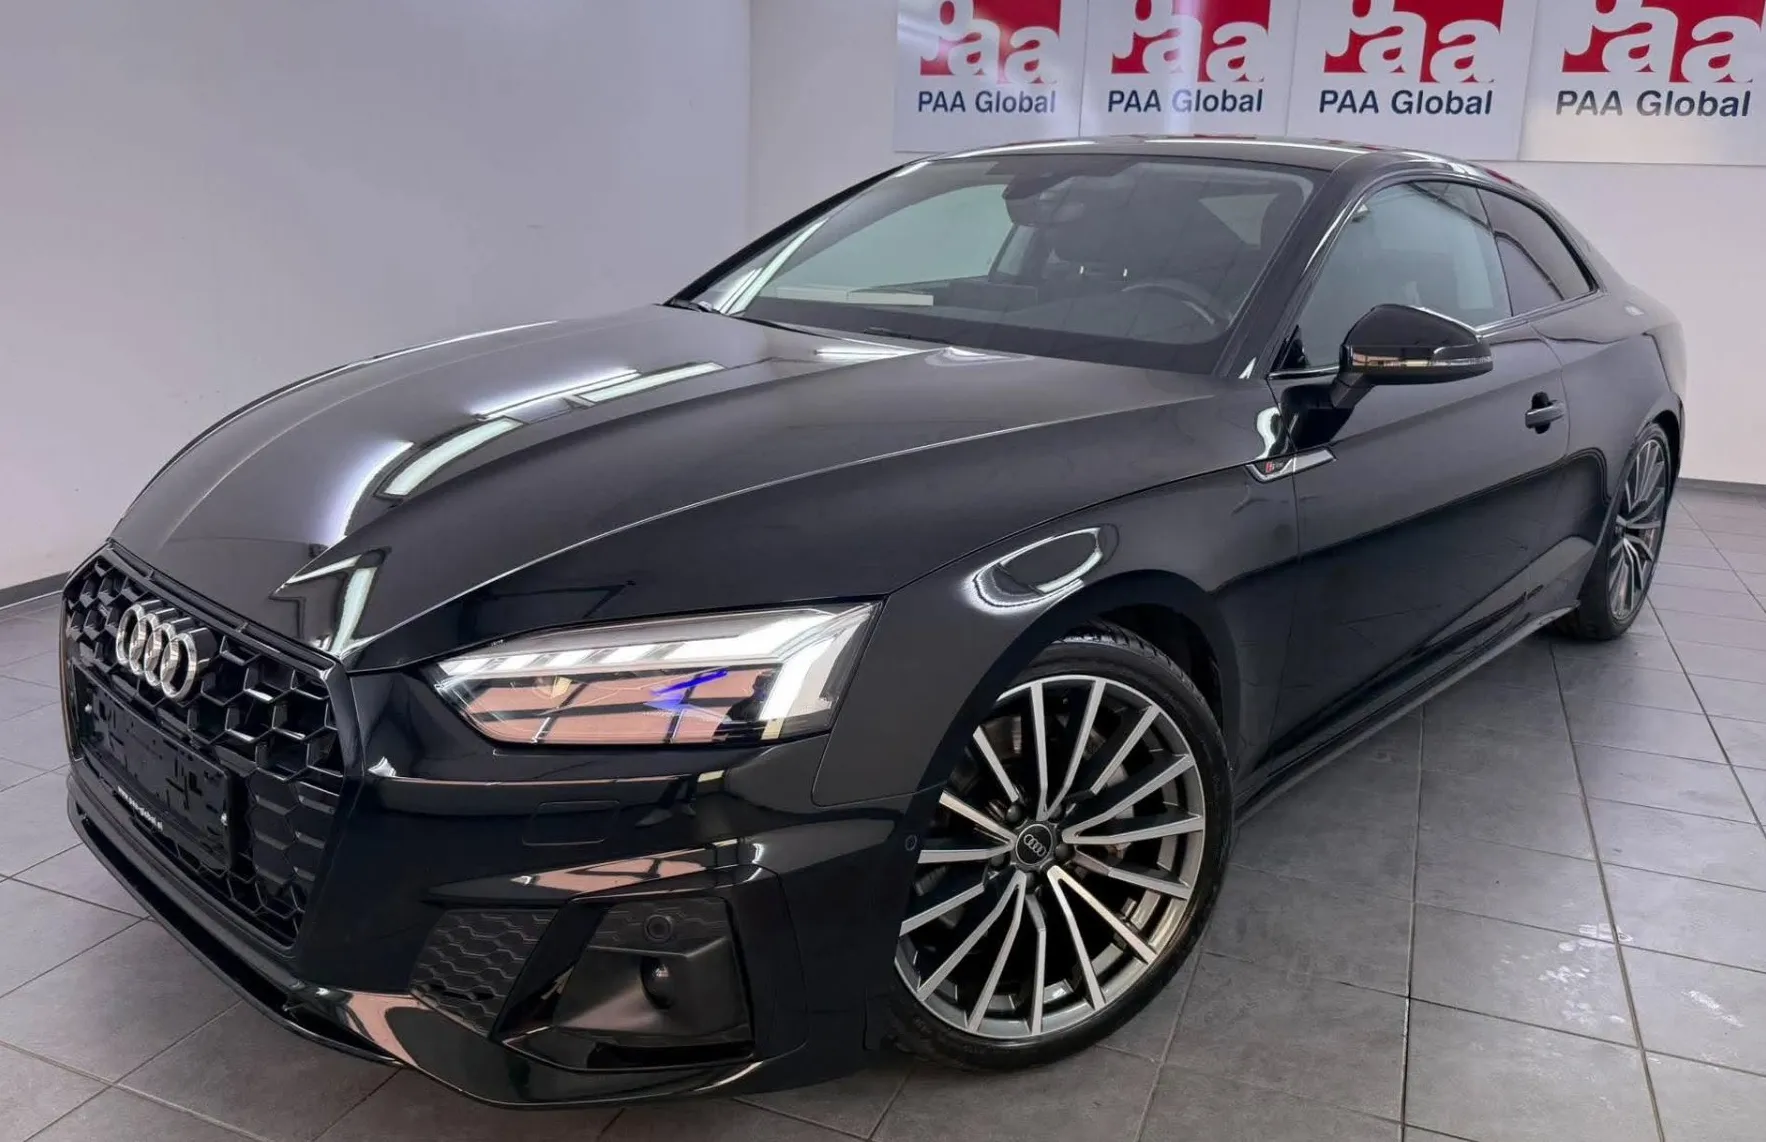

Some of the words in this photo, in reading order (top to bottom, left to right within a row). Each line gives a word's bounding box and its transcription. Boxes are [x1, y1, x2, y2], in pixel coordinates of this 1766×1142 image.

[918, 91, 966, 112] PAA
[975, 90, 1056, 113] Global
[1108, 89, 1161, 112] PAA
[1172, 89, 1263, 113] Global
[1319, 90, 1379, 114] PAA
[1391, 90, 1493, 115] Global
[1556, 90, 1623, 116] PAA
[1636, 90, 1751, 117] Global
